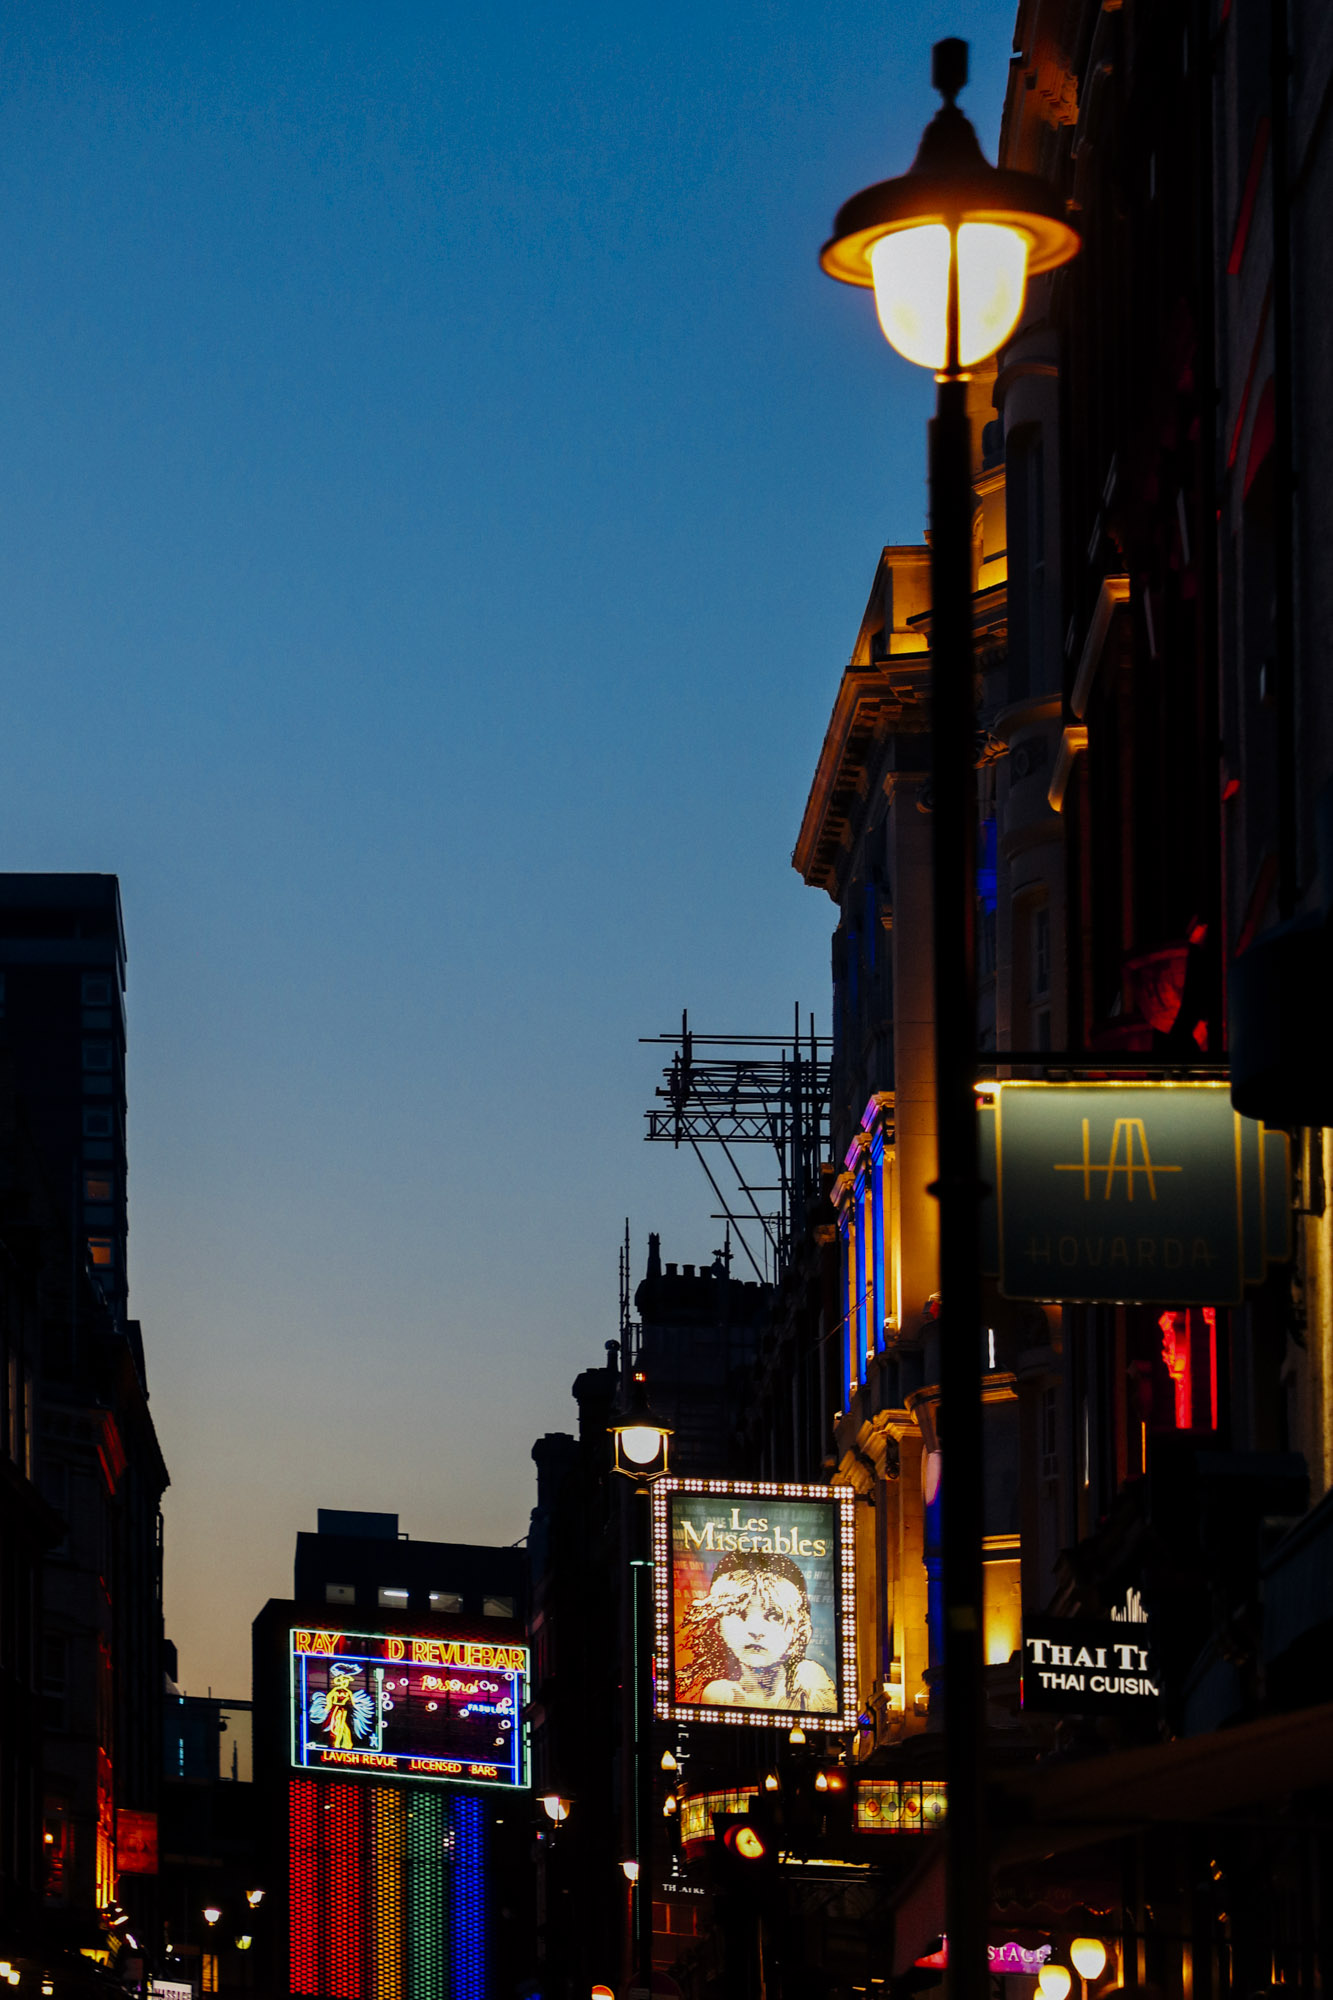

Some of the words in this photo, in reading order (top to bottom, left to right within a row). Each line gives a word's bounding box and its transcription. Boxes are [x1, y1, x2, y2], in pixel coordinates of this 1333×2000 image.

[1024, 1236, 1220, 1269] HOVARDA
[731, 1508, 768, 1532] Les
[681, 1520, 827, 1557] Misérables
[1026, 1638, 1108, 1669] THAI
[1038, 1672, 1085, 1691] THAI
[322, 1750, 359, 1764] LAVISH
[362, 1752, 398, 1767] REVUE
[411, 1759, 462, 1773] LICENSED
[471, 1764, 498, 1777] BARS
